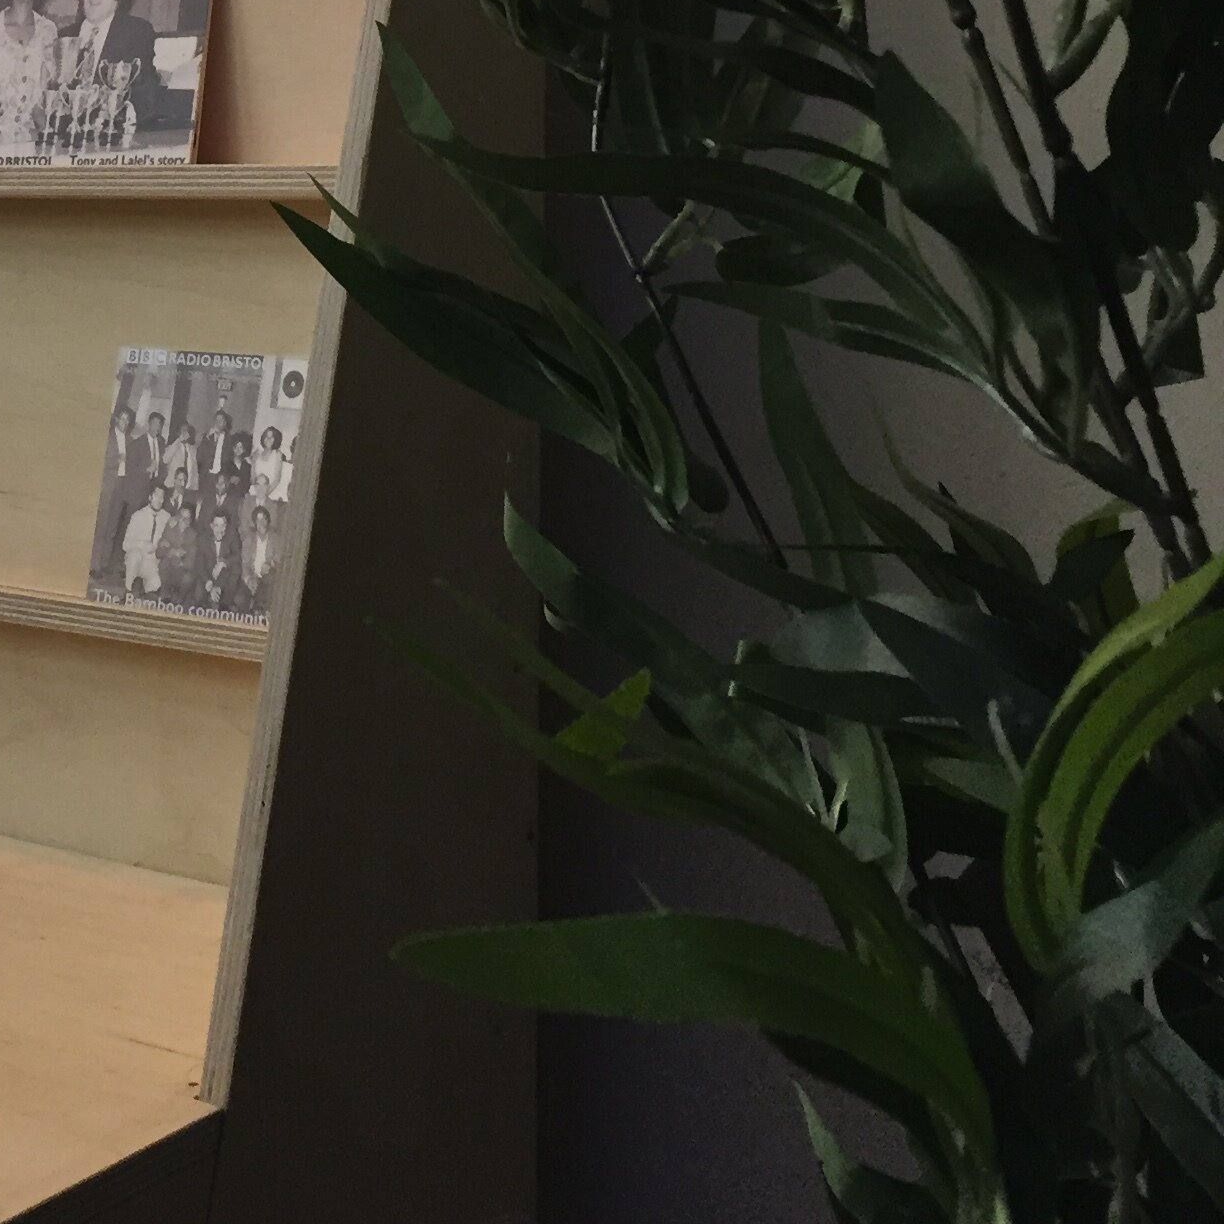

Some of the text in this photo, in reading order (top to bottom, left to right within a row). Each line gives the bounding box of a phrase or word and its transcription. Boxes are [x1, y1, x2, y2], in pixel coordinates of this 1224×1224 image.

[70, 155, 97, 166] Tony
[98, 155, 119, 166] and
[157, 155, 186, 166] story
[127, 349, 167, 366] BBC
[93, 587, 121, 606] The
[125, 592, 185, 616] Bamboo
